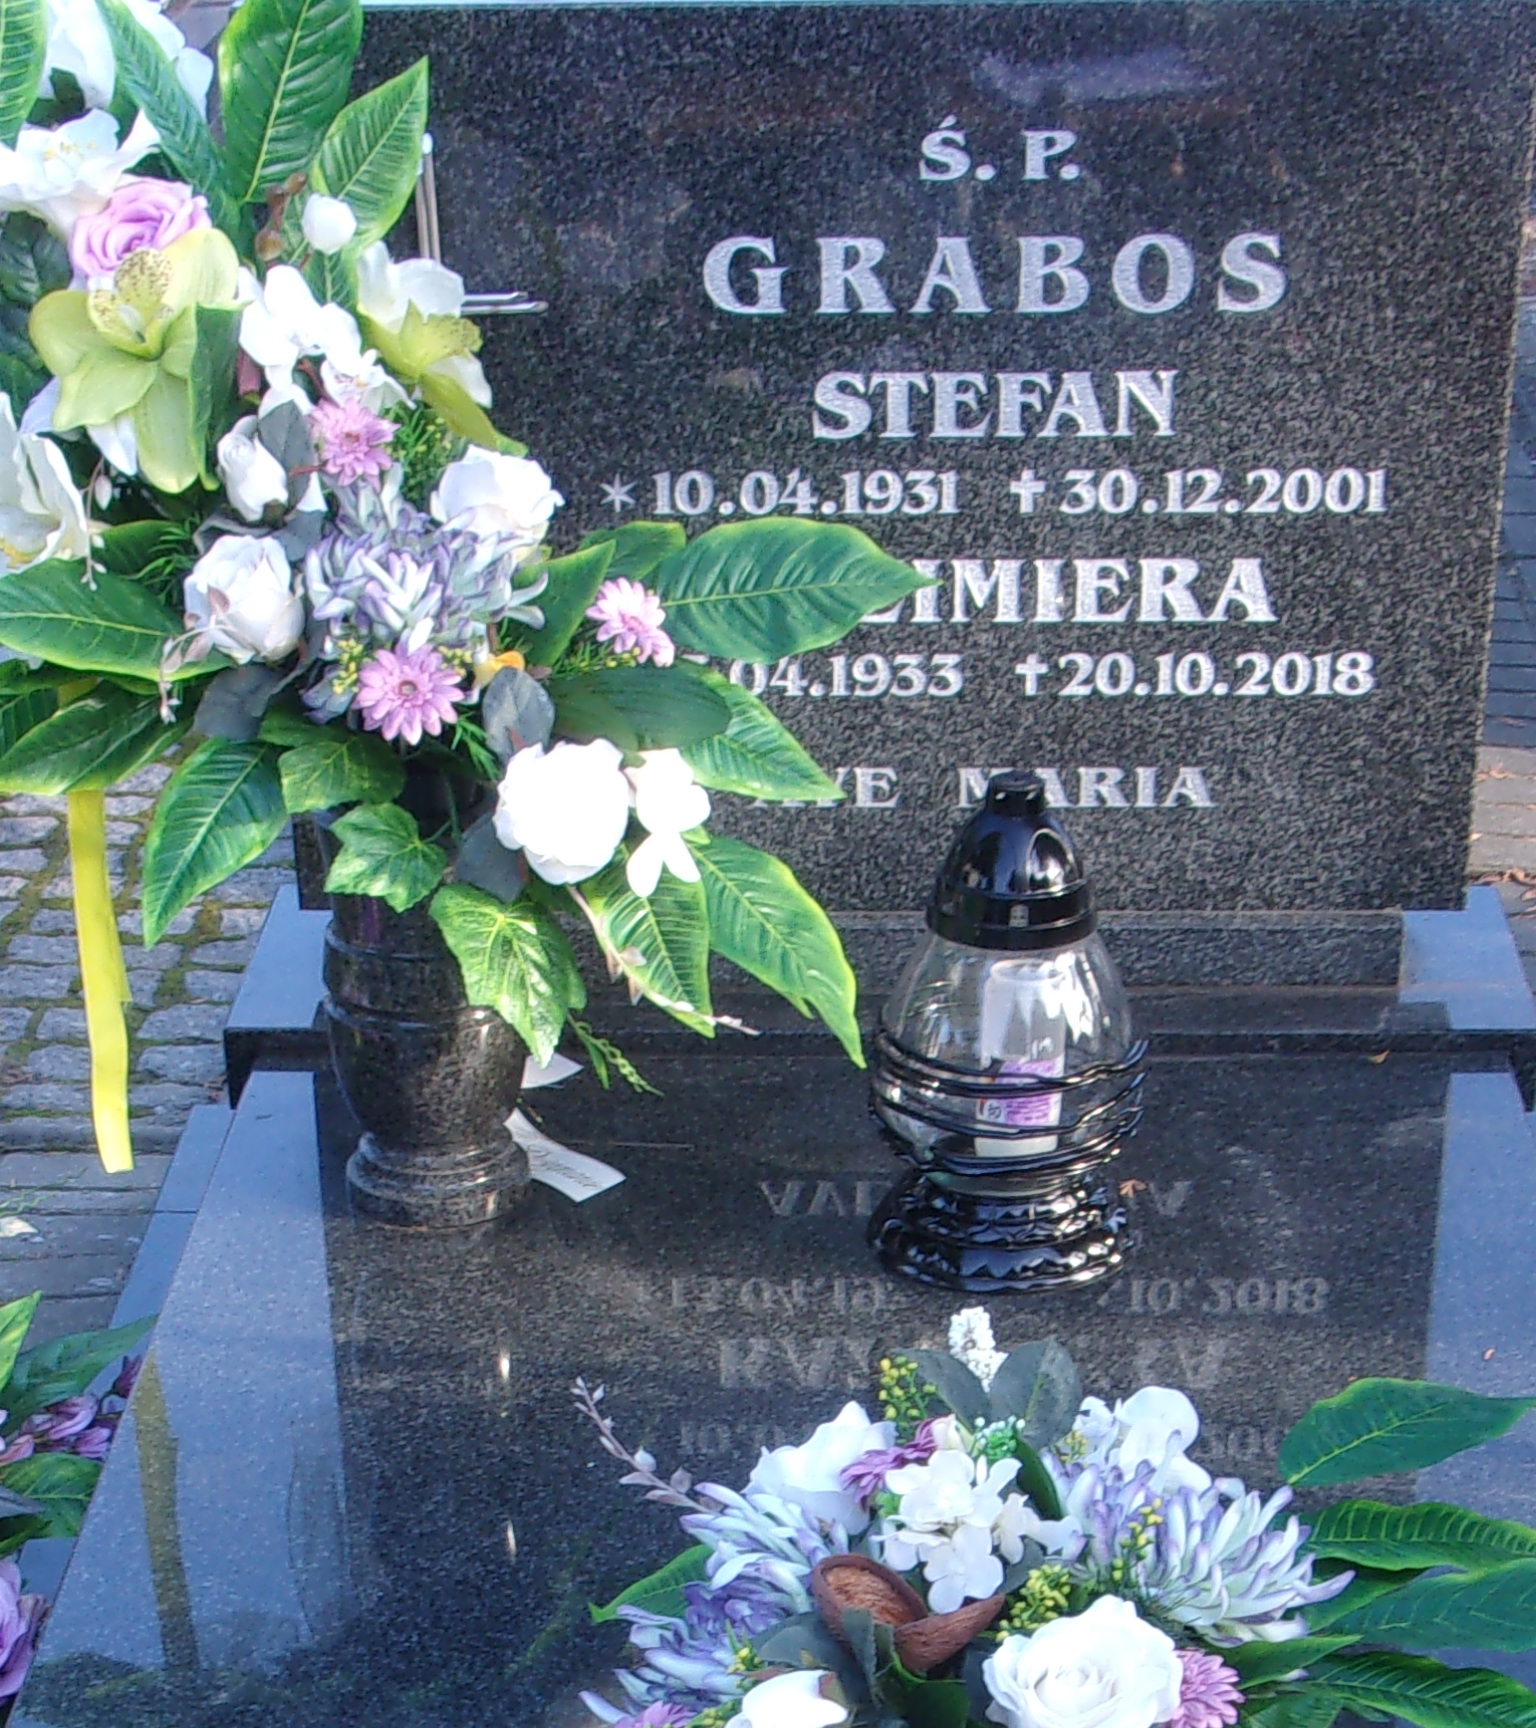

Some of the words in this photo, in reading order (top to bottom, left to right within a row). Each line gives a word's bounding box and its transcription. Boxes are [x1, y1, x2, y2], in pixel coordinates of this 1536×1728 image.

[919, 114, 996, 181] Ś.
[1021, 130, 1080, 181] P.
[702, 233, 1288, 315] GRABOS
[812, 369, 1178, 439] STEFAN
[652, 468, 961, 516] 10.04.1931
[1059, 467, 1389, 515] 30.12.2001
[681, 652, 964, 698] 04.1933
[1058, 651, 1375, 697] 20.10.2018
